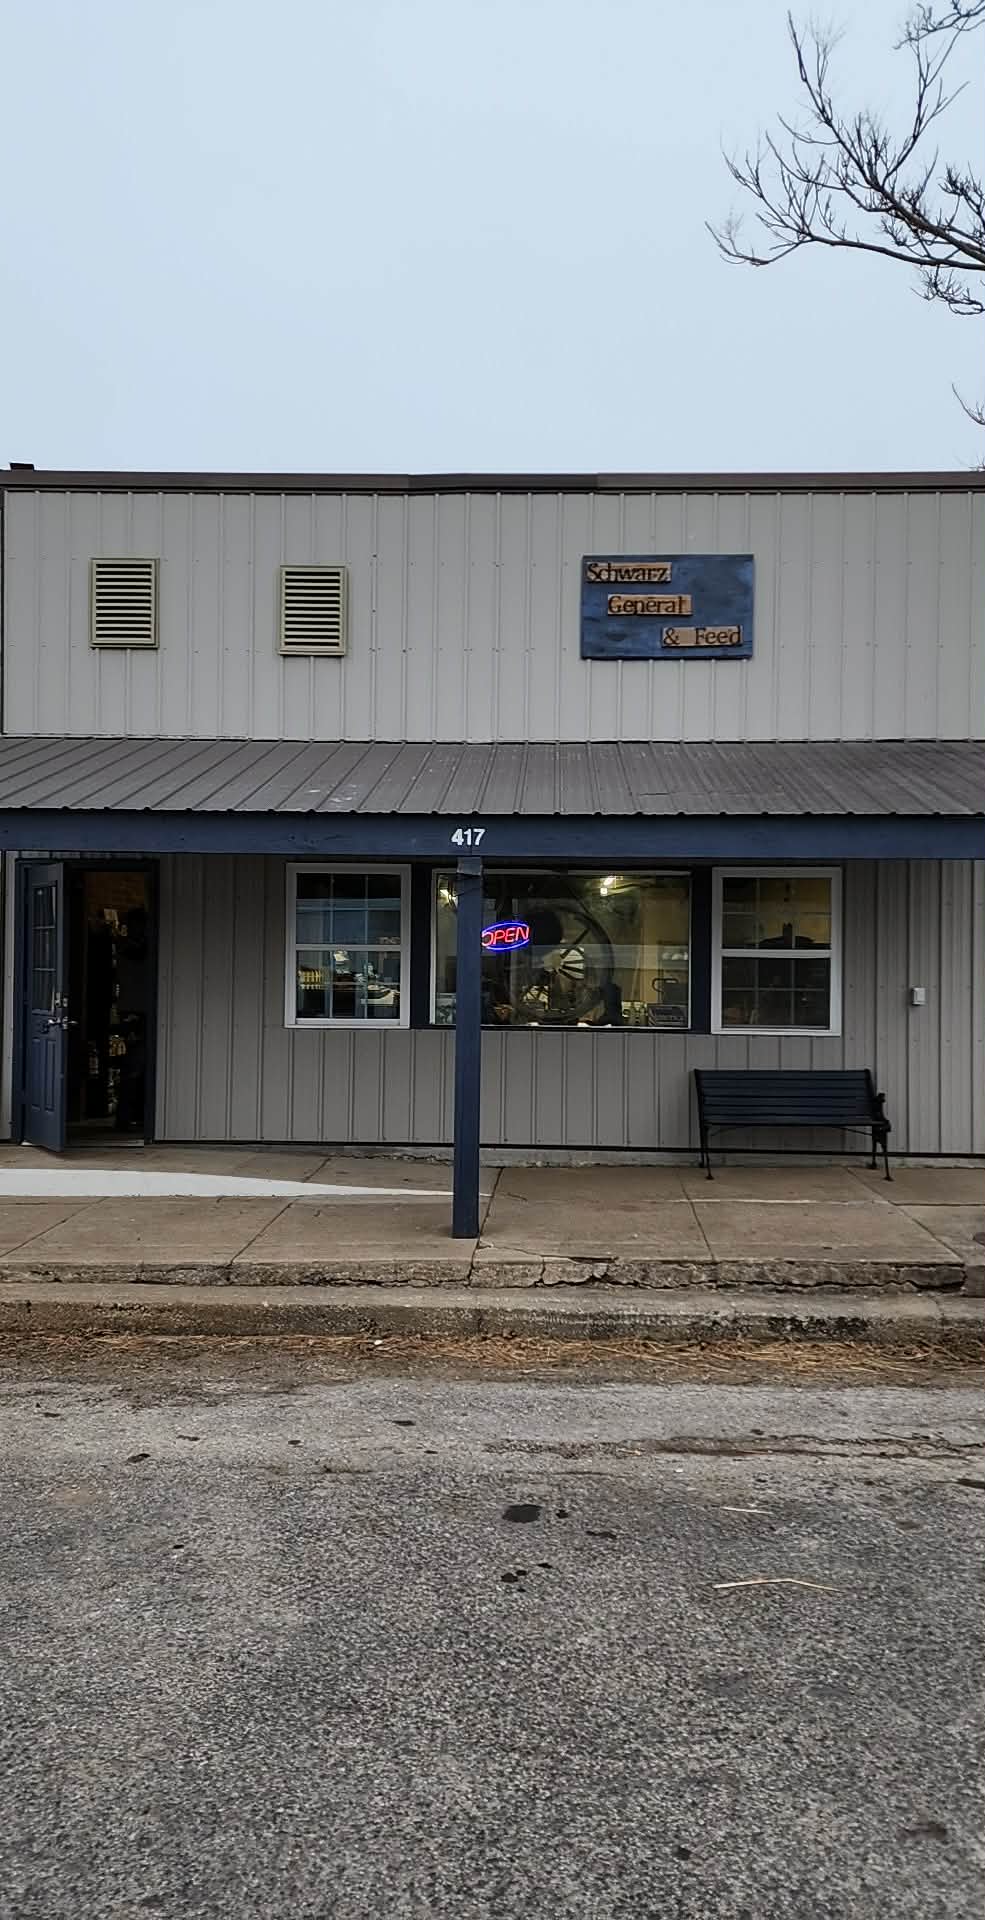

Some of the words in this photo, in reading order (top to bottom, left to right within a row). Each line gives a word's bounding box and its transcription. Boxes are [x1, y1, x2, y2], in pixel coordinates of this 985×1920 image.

[587, 562, 669, 581] Schwarz
[607, 595, 683, 614] General
[662, 627, 680, 646] &
[694, 625, 741, 645] Feed
[451, 828, 486, 846] 417
[481, 926, 530, 947] OPEN
